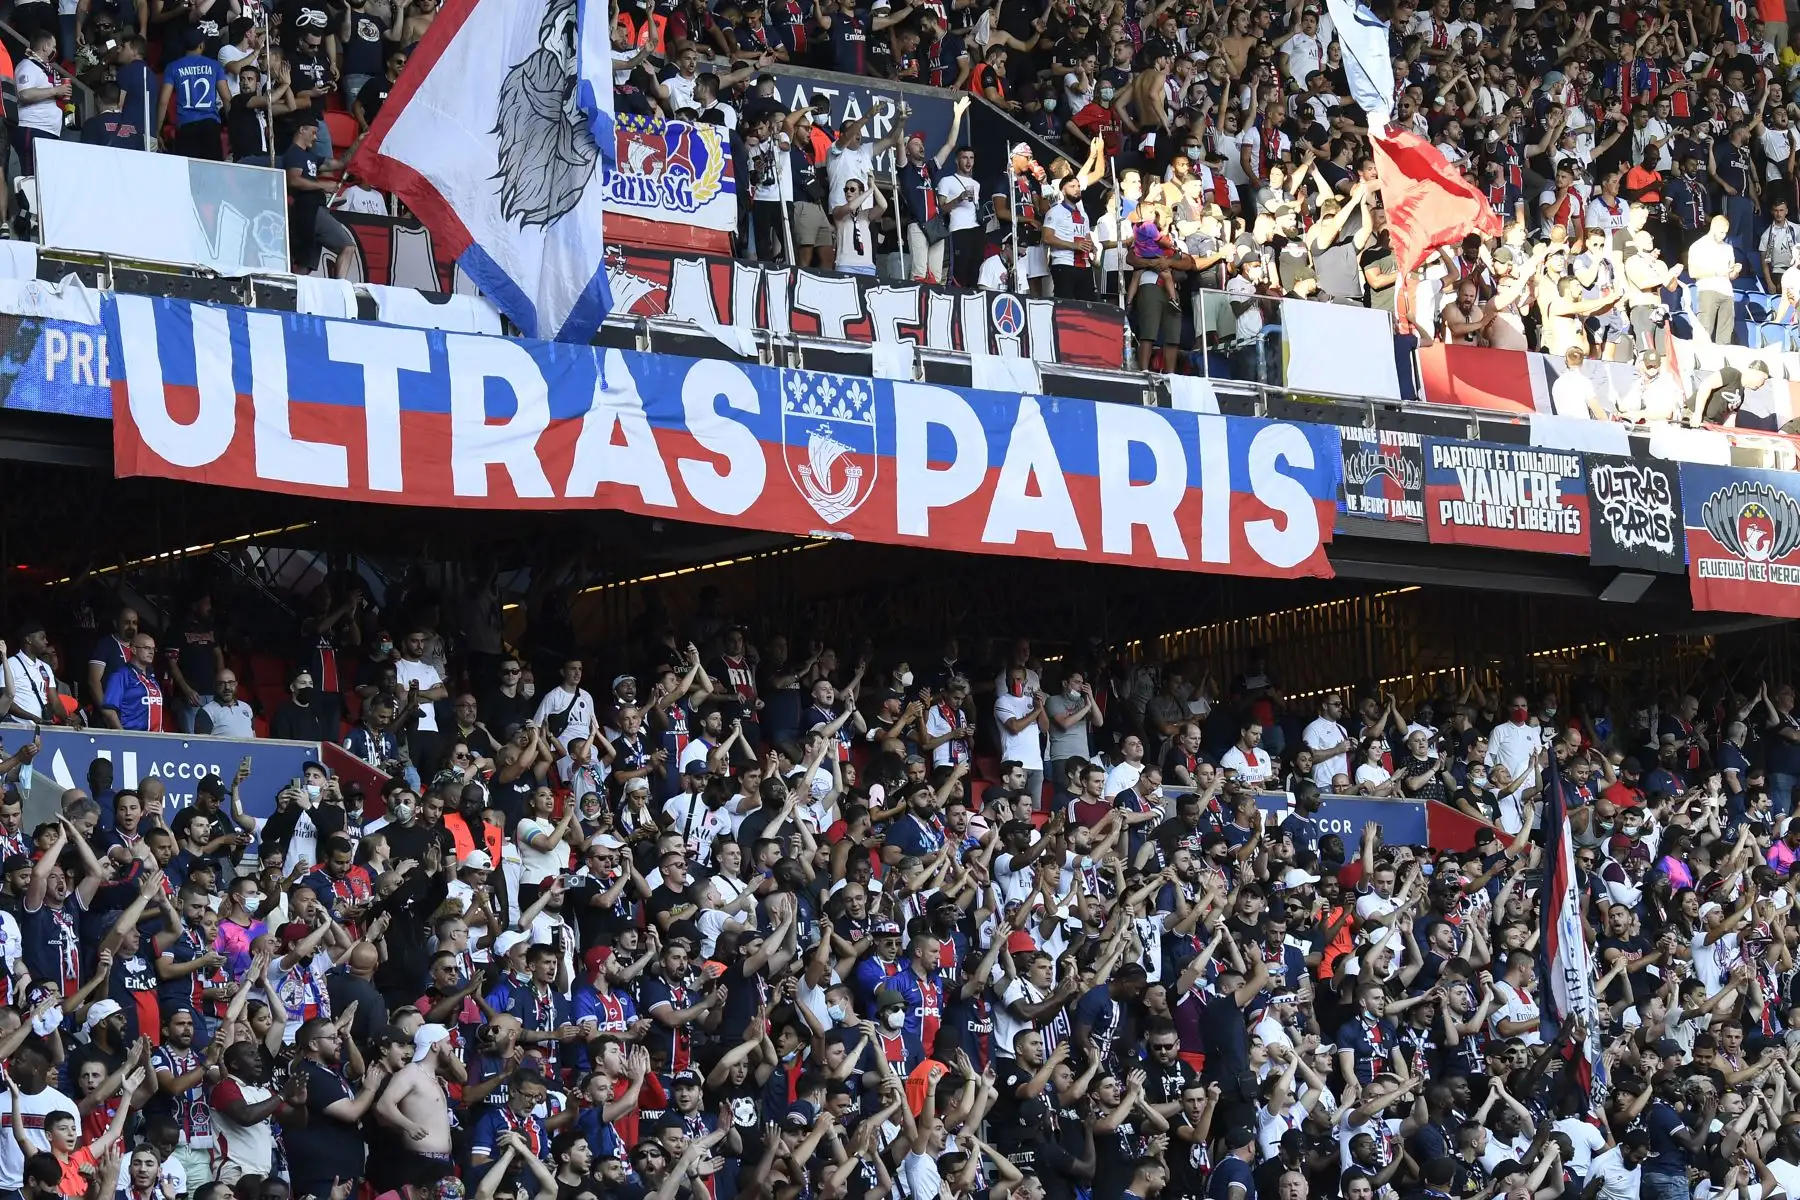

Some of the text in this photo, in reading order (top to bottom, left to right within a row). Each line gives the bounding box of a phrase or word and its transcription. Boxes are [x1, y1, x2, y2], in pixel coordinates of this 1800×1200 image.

[179, 64, 213, 77] NAUTECIA
[180, 79, 213, 109] 12
[773, 80, 896, 140] ATAR
[115, 293, 1322, 570] ULTRAS PARIS
[1432, 444, 1580, 478] PARTOUT ET TOUJOURS
[1456, 466, 1563, 511] VAINCRE
[1593, 464, 1672, 509] ULTRAS
[1439, 500, 1581, 535] POUR NOS LIBERTÉS
[1604, 503, 1673, 548] PARIS
[1699, 559, 1745, 578] FLUCTUAT
[1749, 561, 1767, 581] NEC
